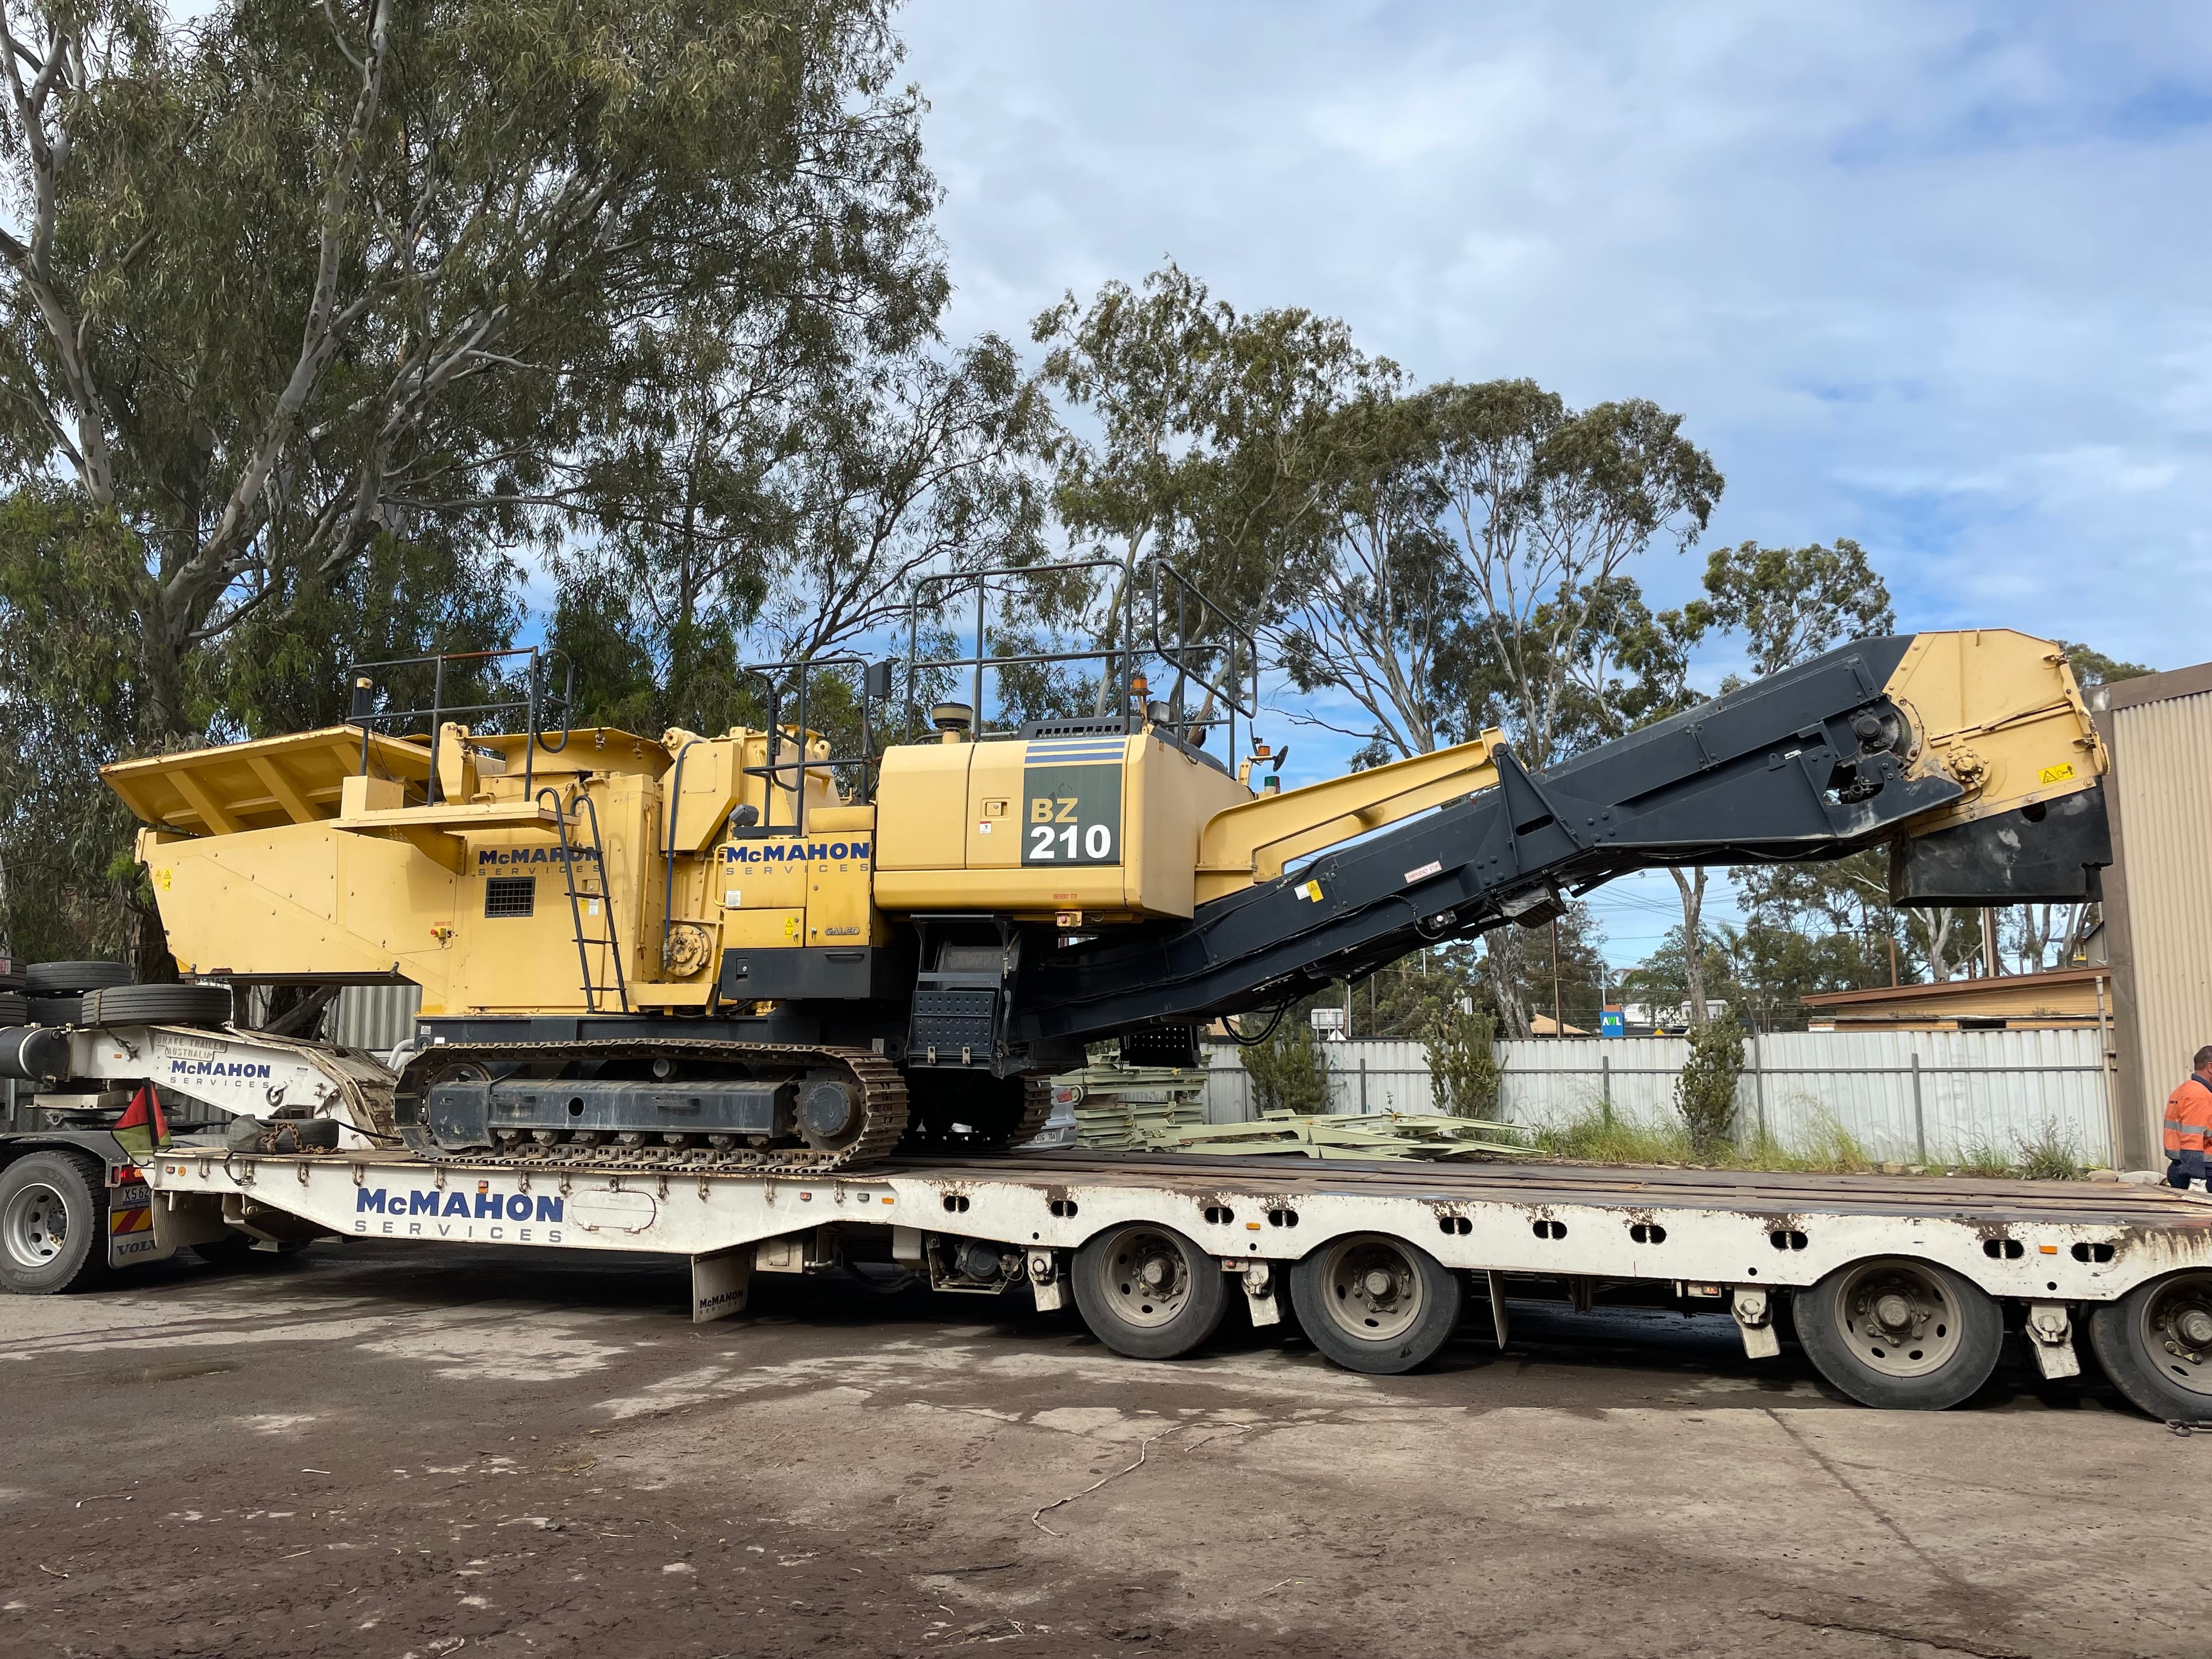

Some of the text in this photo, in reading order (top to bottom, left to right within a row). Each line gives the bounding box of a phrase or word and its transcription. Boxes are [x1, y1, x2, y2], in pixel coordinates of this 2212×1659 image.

[1031, 798, 1078, 823] BZ
[1029, 824, 1111, 859] 210
[479, 846, 600, 865] McMAHON
[727, 843, 870, 863] McMAHON
[479, 865, 600, 876] SERVICES
[726, 863, 869, 875] SERVICES
[825, 927, 860, 936] GALEO
[1602, 1016, 1622, 1026] AWL
[157, 1035, 185, 1046] DRAKE
[166, 1047, 213, 1059] AUSTRALIA
[172, 1060, 271, 1078] McMAHON
[170, 1077, 269, 1089] SERVICES
[356, 1187, 564, 1223] McMAHON
[354, 1220, 562, 1243] SERVICES
[116, 1239, 157, 1256] VOL
[699, 1288, 743, 1309] McMAHON
